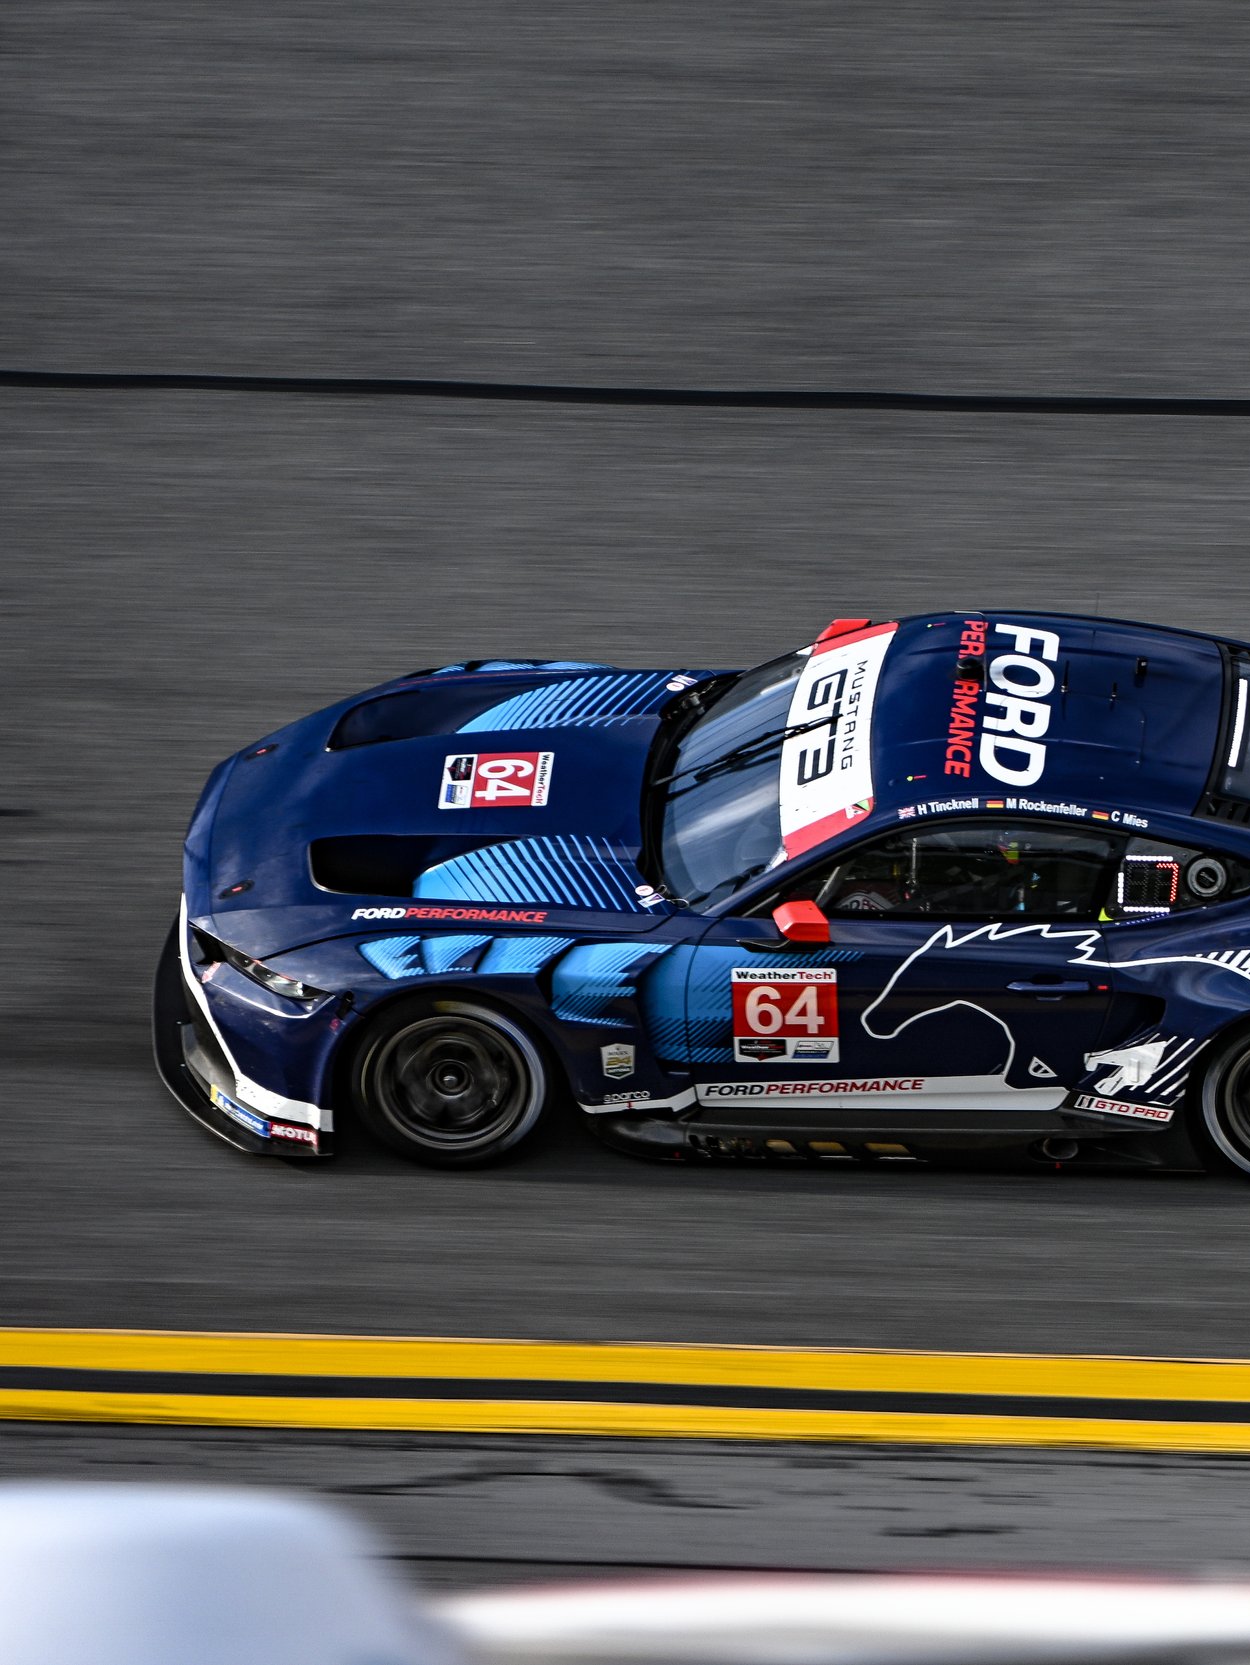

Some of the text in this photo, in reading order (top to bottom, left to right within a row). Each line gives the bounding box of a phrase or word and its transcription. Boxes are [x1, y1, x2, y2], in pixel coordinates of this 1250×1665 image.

[840, 659, 868, 771] MUSTANG
[944, 619, 989, 778] PERRMANCE
[979, 623, 1060, 787] FORD
[796, 668, 848, 786] GT3
[474, 759, 535, 801] 64
[534, 754, 551, 805] WeatherTech
[917, 798, 1149, 828] H Tincknell M Rockenfeller C Mies
[736, 971, 832, 980] WeatherTech
[745, 985, 825, 1035] 64
[1095, 1101, 1169, 1119] GTD PRO
